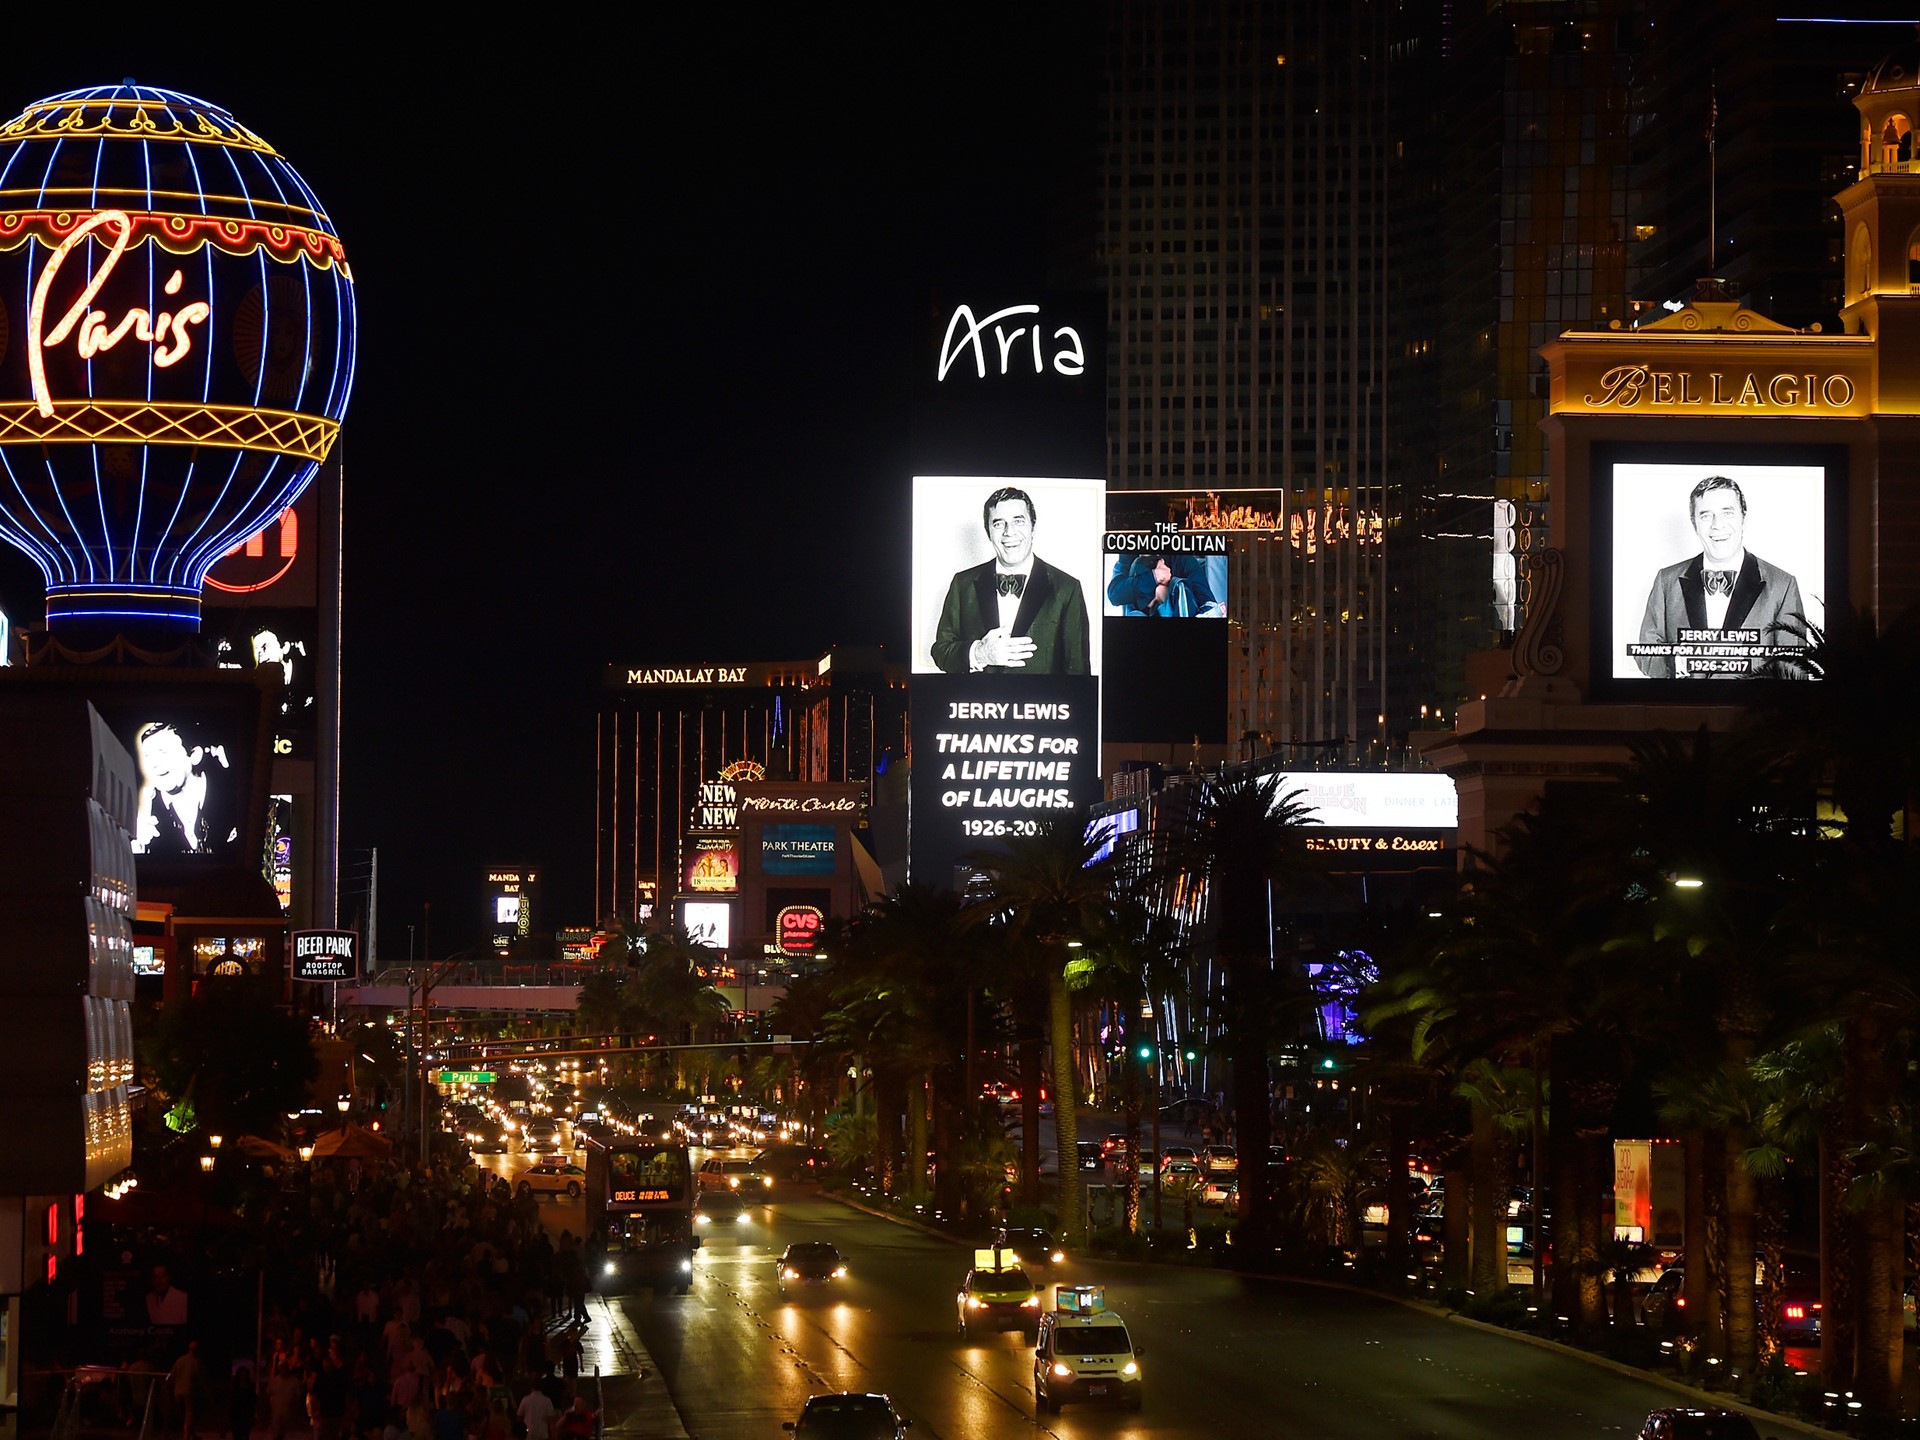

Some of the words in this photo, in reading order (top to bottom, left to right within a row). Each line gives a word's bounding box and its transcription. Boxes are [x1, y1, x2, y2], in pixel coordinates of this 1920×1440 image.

[28, 209, 210, 418] Paris
[937, 303, 1086, 382] Aria
[1584, 364, 1856, 409] BELLAGIO
[1154, 522, 1179, 534] THE
[1106, 533, 1226, 553] COSMOPOLITAN
[1680, 630, 1718, 642] JERRY
[1720, 630, 1758, 642] LEWIS
[1631, 646, 1671, 656] THANKS
[1672, 646, 1693, 656] FOR
[1694, 647, 1702, 656] A
[1703, 646, 1748, 656] LIFETIME
[1750, 646, 1764, 657] OF
[1689, 660, 1749, 672] 1926-2017
[627, 669, 714, 683] MANDALAY
[717, 668, 748, 683] BAY
[949, 703, 1009, 720] JERRY
[1013, 703, 1071, 721] LEWIS
[936, 733, 1034, 754] THANKS
[1038, 738, 1079, 754] FOR
[942, 763, 956, 780] A
[960, 761, 1071, 781] LIFETIME
[702, 784, 737, 802] NEW
[1304, 782, 1355, 797] BLUE
[741, 796, 800, 812] Monte
[801, 797, 856, 812] Carlo
[942, 791, 971, 807] OF
[973, 789, 1075, 808] LAUGHS.
[1384, 797, 1425, 806] DINNER
[702, 807, 738, 825] NEW
[962, 820, 1054, 836] 1926-20
[696, 843, 733, 853] ZUMANITY
[762, 841, 788, 851] PARK
[790, 841, 835, 851] THEATER
[1375, 839, 1388, 850] &
[1391, 837, 1439, 851] Essex
[488, 873, 535, 882] MANDAY
[783, 913, 819, 929] CVS
[297, 937, 322, 957] BEER
[326, 937, 352, 957] PARK
[452, 1073, 478, 1081] Paris
[615, 1191, 636, 1200] DEUCE
